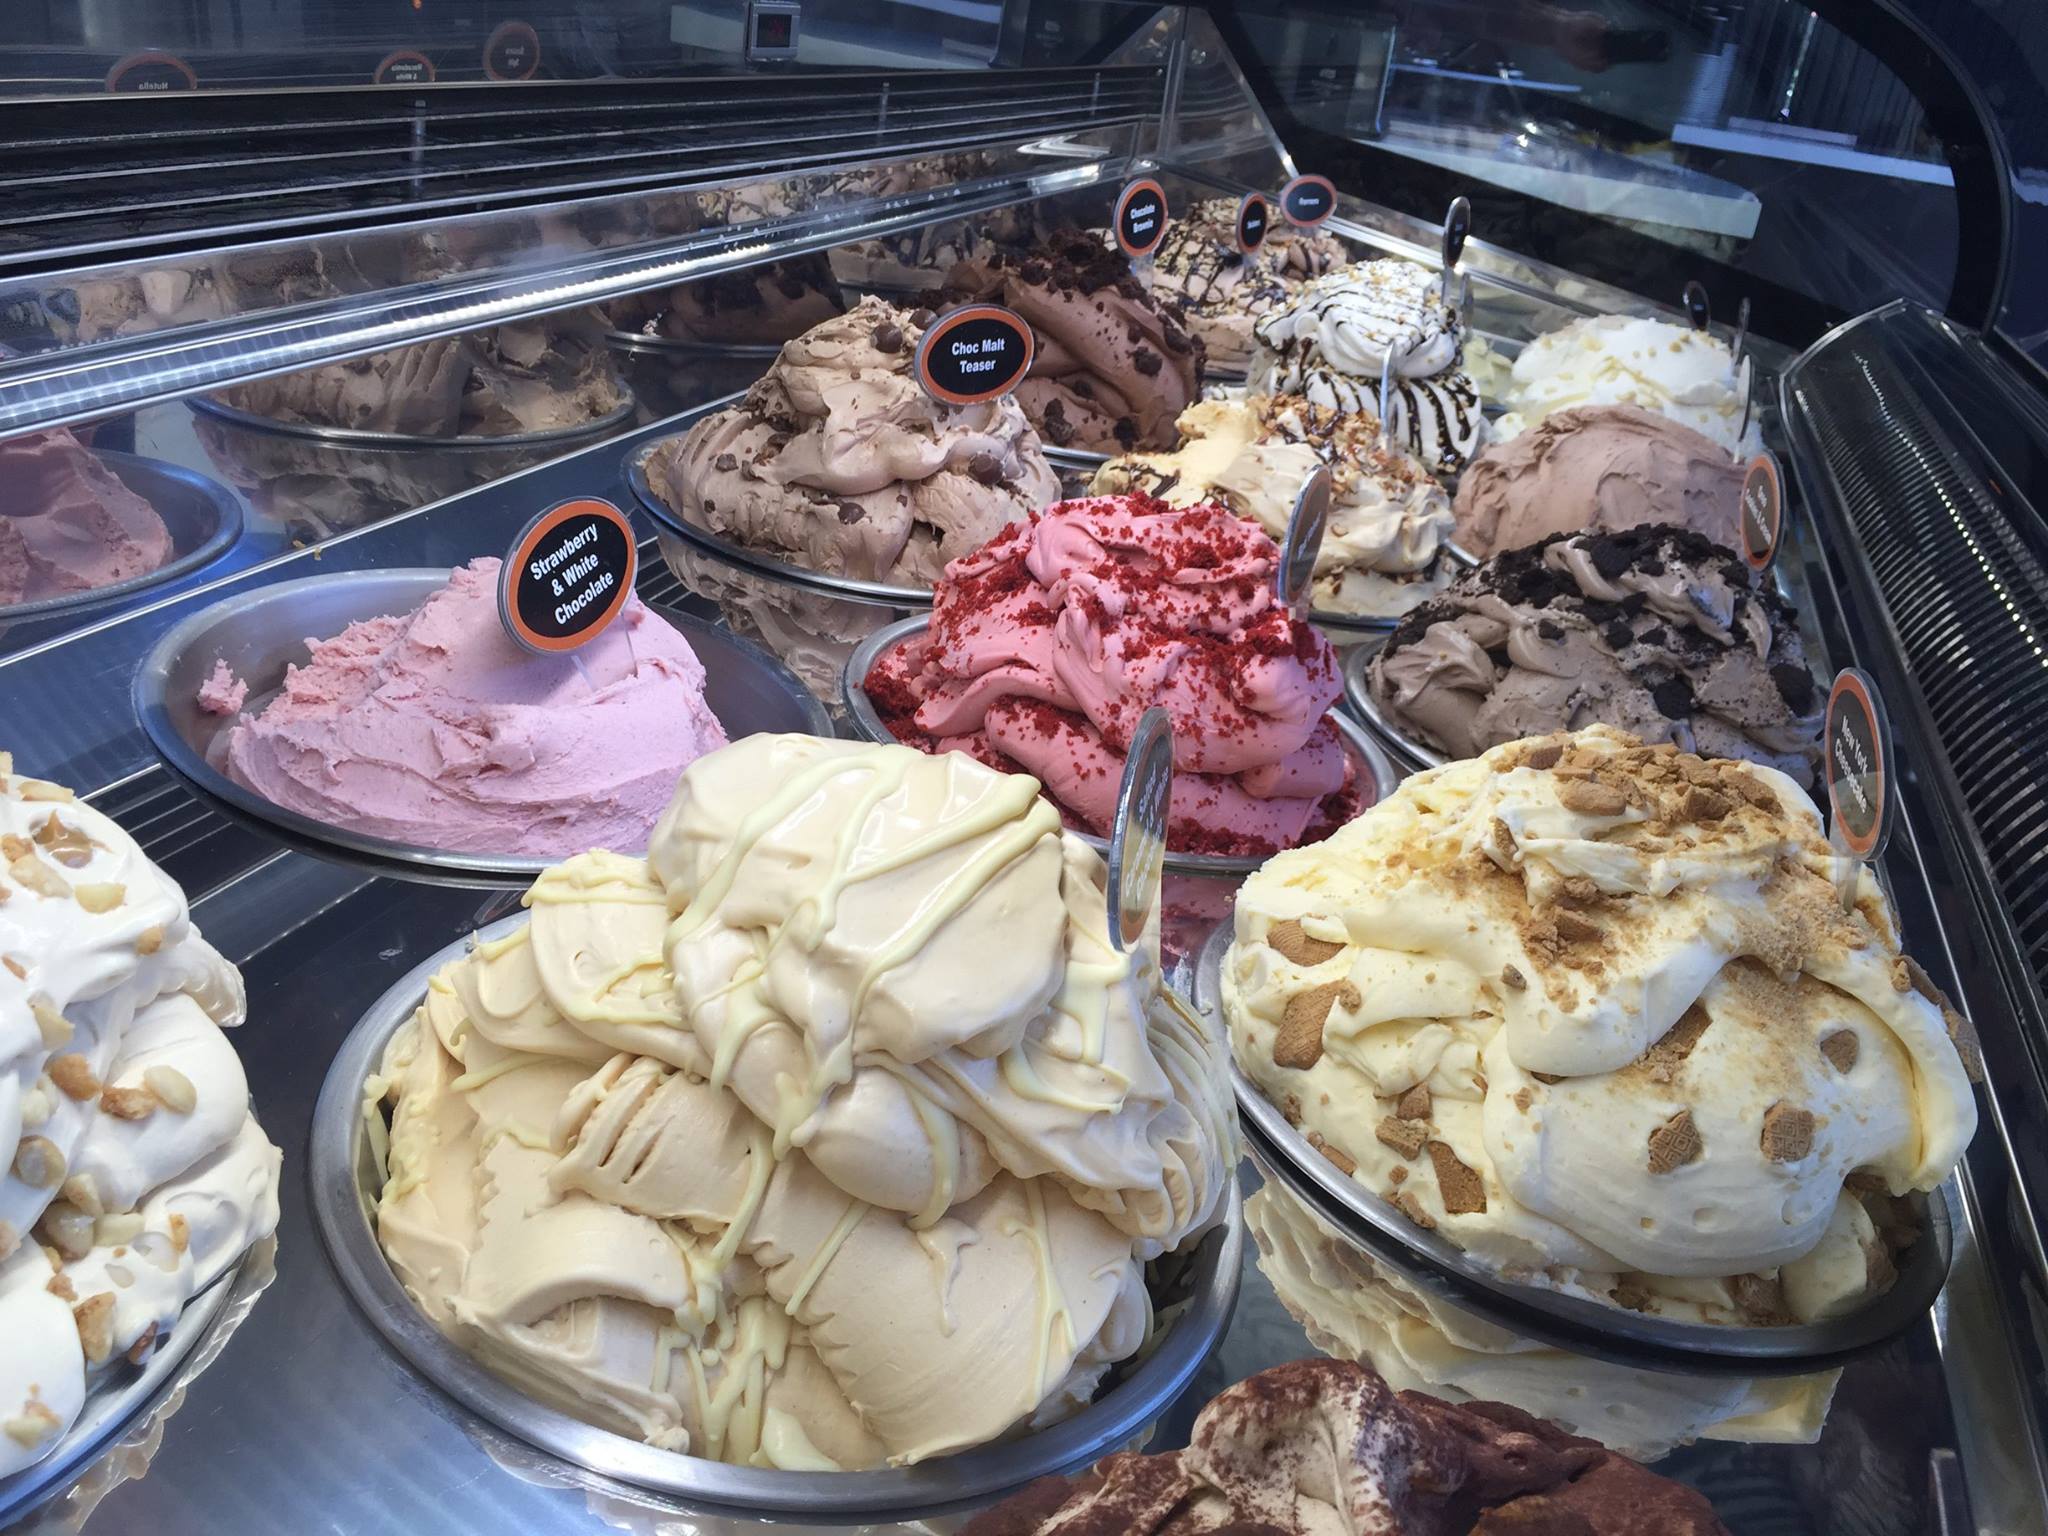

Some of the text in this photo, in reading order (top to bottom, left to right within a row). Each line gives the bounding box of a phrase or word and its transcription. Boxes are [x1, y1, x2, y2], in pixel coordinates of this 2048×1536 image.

[951, 338, 1005, 356] Choc Malt
[959, 359, 997, 374] Teaser
[530, 523, 598, 581] Strawberry
[551, 553, 599, 597] & White
[554, 571, 614, 625] Chocolate
[1841, 714, 1869, 778] New York
